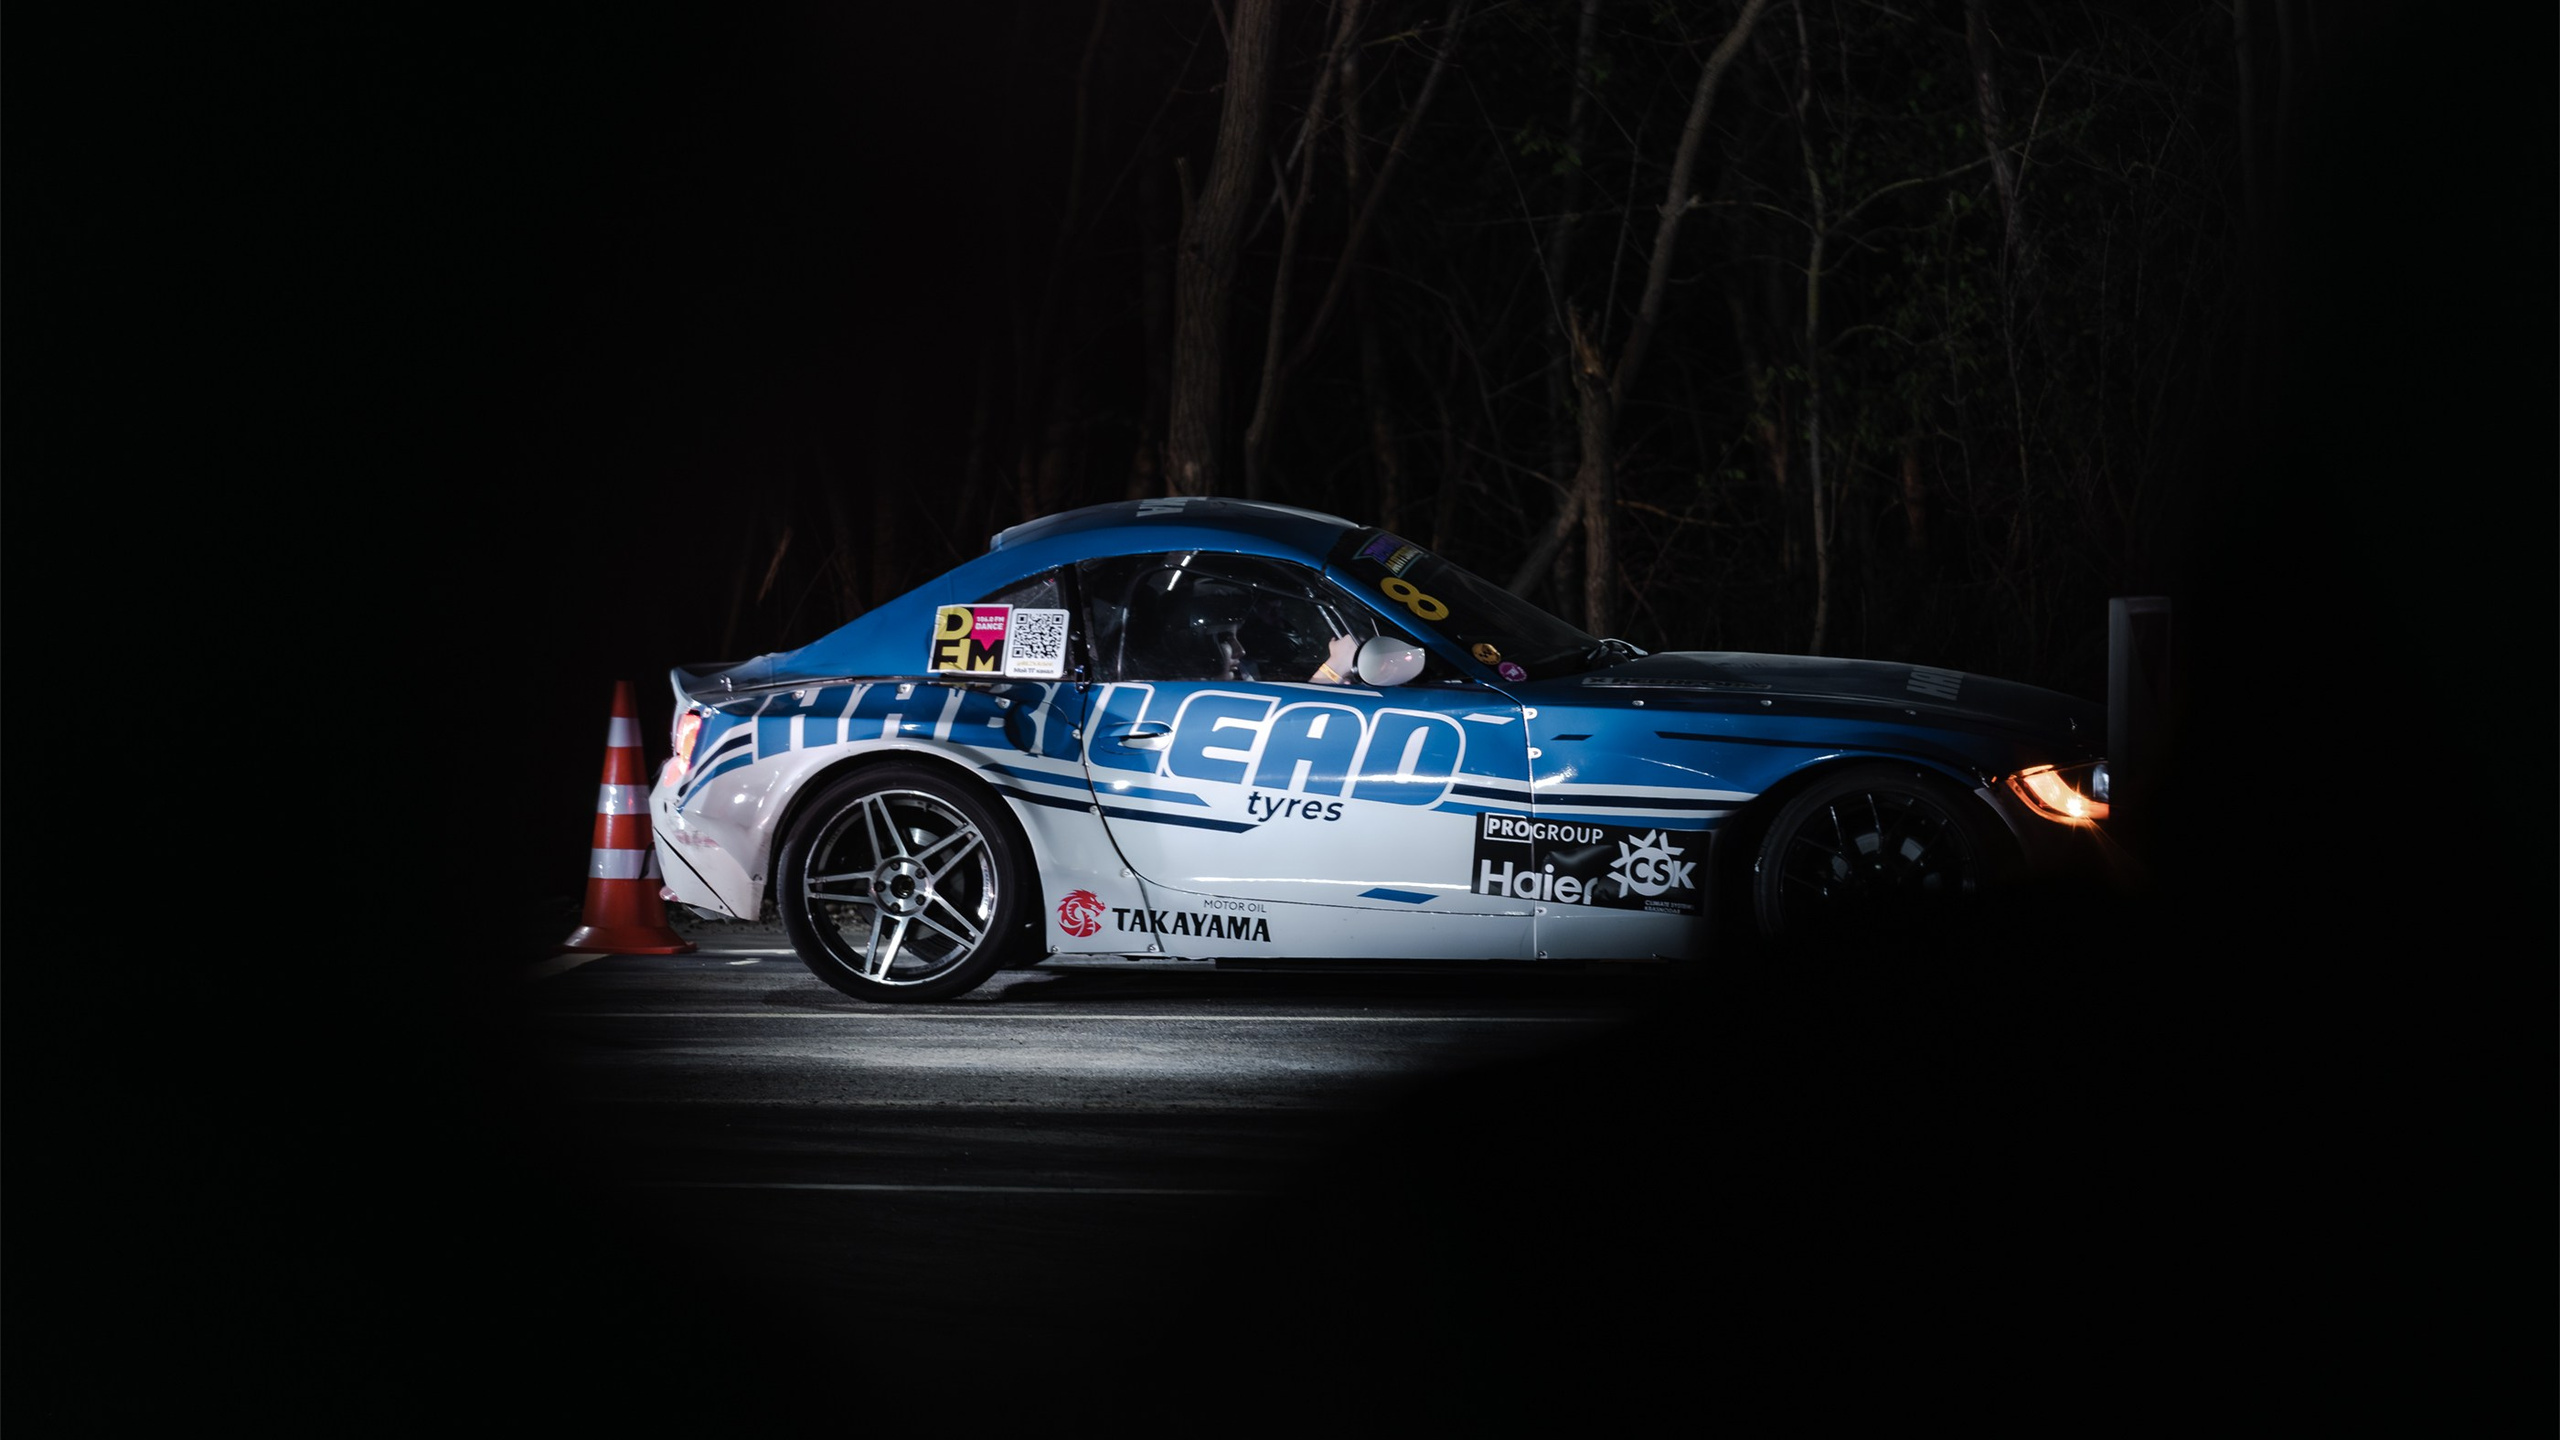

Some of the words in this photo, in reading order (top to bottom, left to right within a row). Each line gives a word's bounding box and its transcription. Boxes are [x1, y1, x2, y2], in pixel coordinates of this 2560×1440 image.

[1379, 576, 1451, 621] 8
[975, 622, 1004, 631] DANCE
[755, 683, 1466, 808] HABILEAD
[1247, 790, 1343, 824] tyres
[1478, 858, 1599, 906] Haier
[1629, 856, 1698, 890] CSK
[1203, 899, 1245, 912] MOTOR
[1248, 902, 1267, 913] OIL
[1111, 907, 1272, 943] TAKAYAMA
